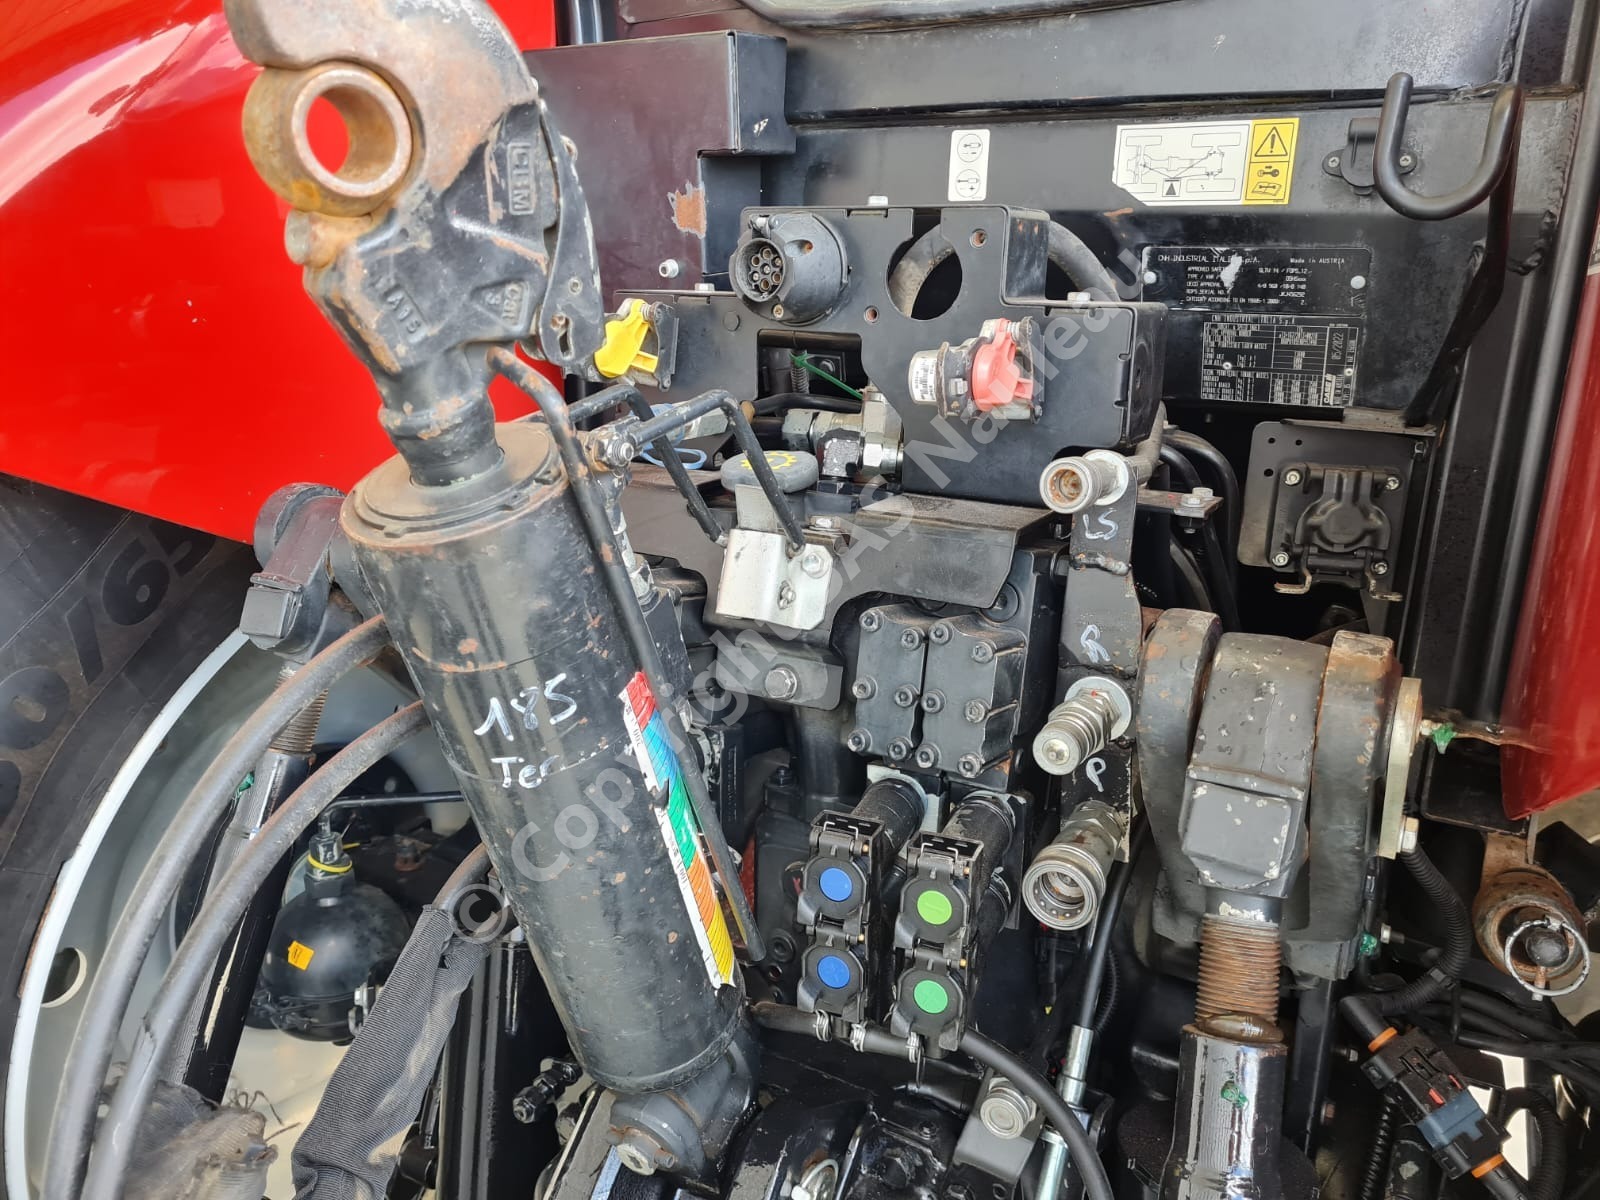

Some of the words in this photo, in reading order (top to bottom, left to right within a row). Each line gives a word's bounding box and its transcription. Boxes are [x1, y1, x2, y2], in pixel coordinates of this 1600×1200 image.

[1082, 507, 1119, 541] LS
[1080, 624, 1111, 664] R
[473, 672, 578, 742] 185
[1085, 756, 1107, 793] P
